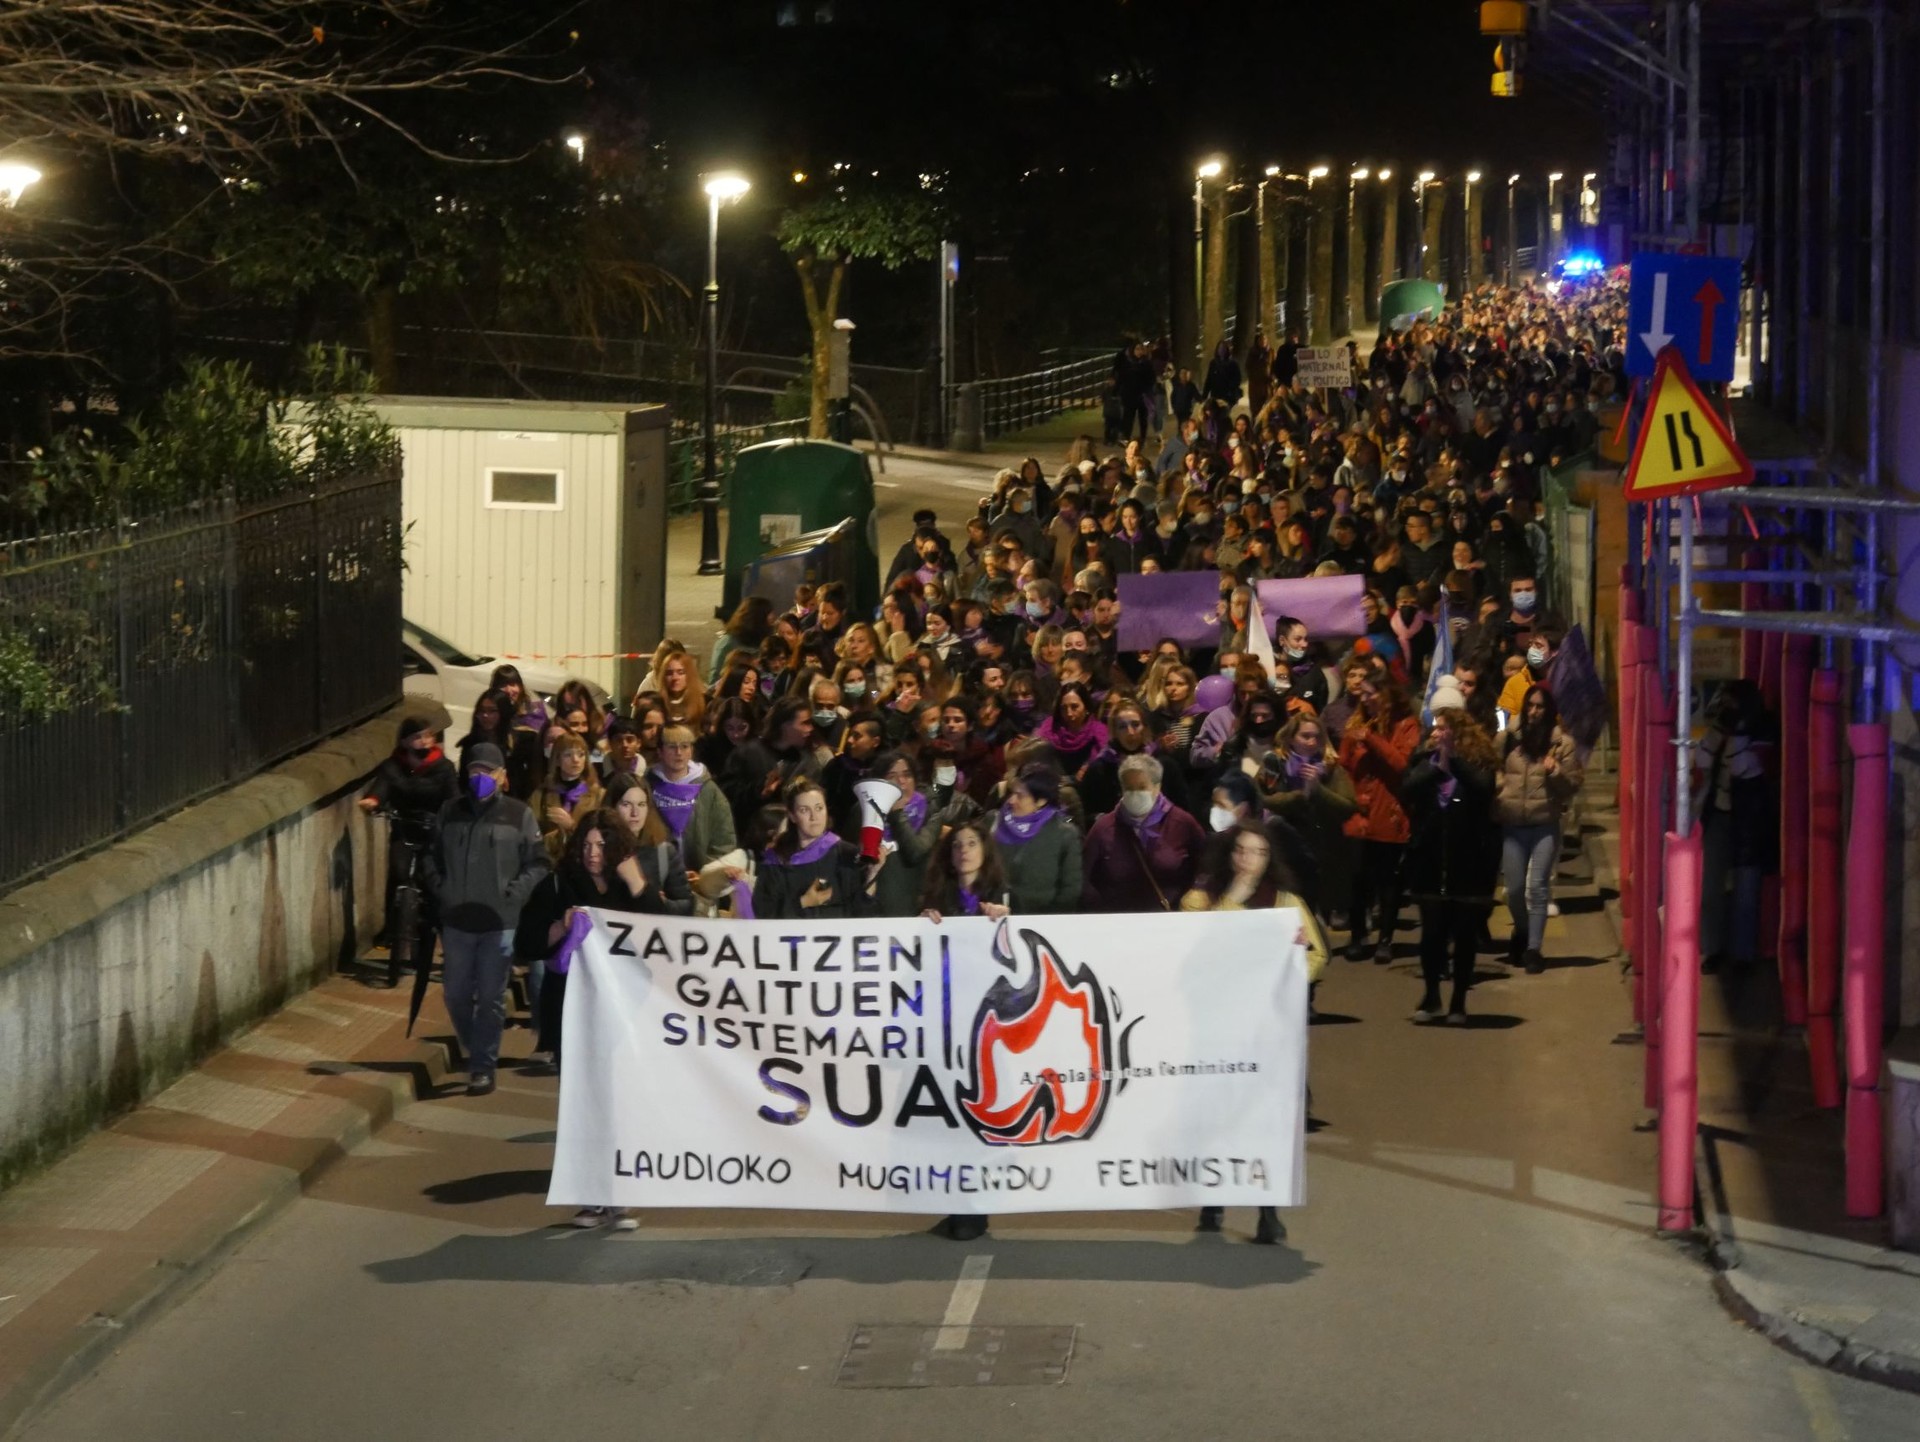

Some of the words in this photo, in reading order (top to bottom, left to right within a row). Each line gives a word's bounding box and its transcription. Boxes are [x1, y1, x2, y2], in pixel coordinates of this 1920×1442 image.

[1298, 361, 1348, 373] MATERNAL
[1317, 349, 1331, 359] LO
[606, 921, 923, 973] ZAPALTZEN
[676, 973, 924, 1018] GAITUEN
[662, 1012, 925, 1059] SISTEMARI
[1159, 1059, 1260, 1077] feminista
[757, 1057, 961, 1129] SUA
[614, 1149, 792, 1185] LAUDIOKO
[838, 1162, 1051, 1194] MUGIMENDU
[1097, 1157, 1270, 1191] FEMINISTA
